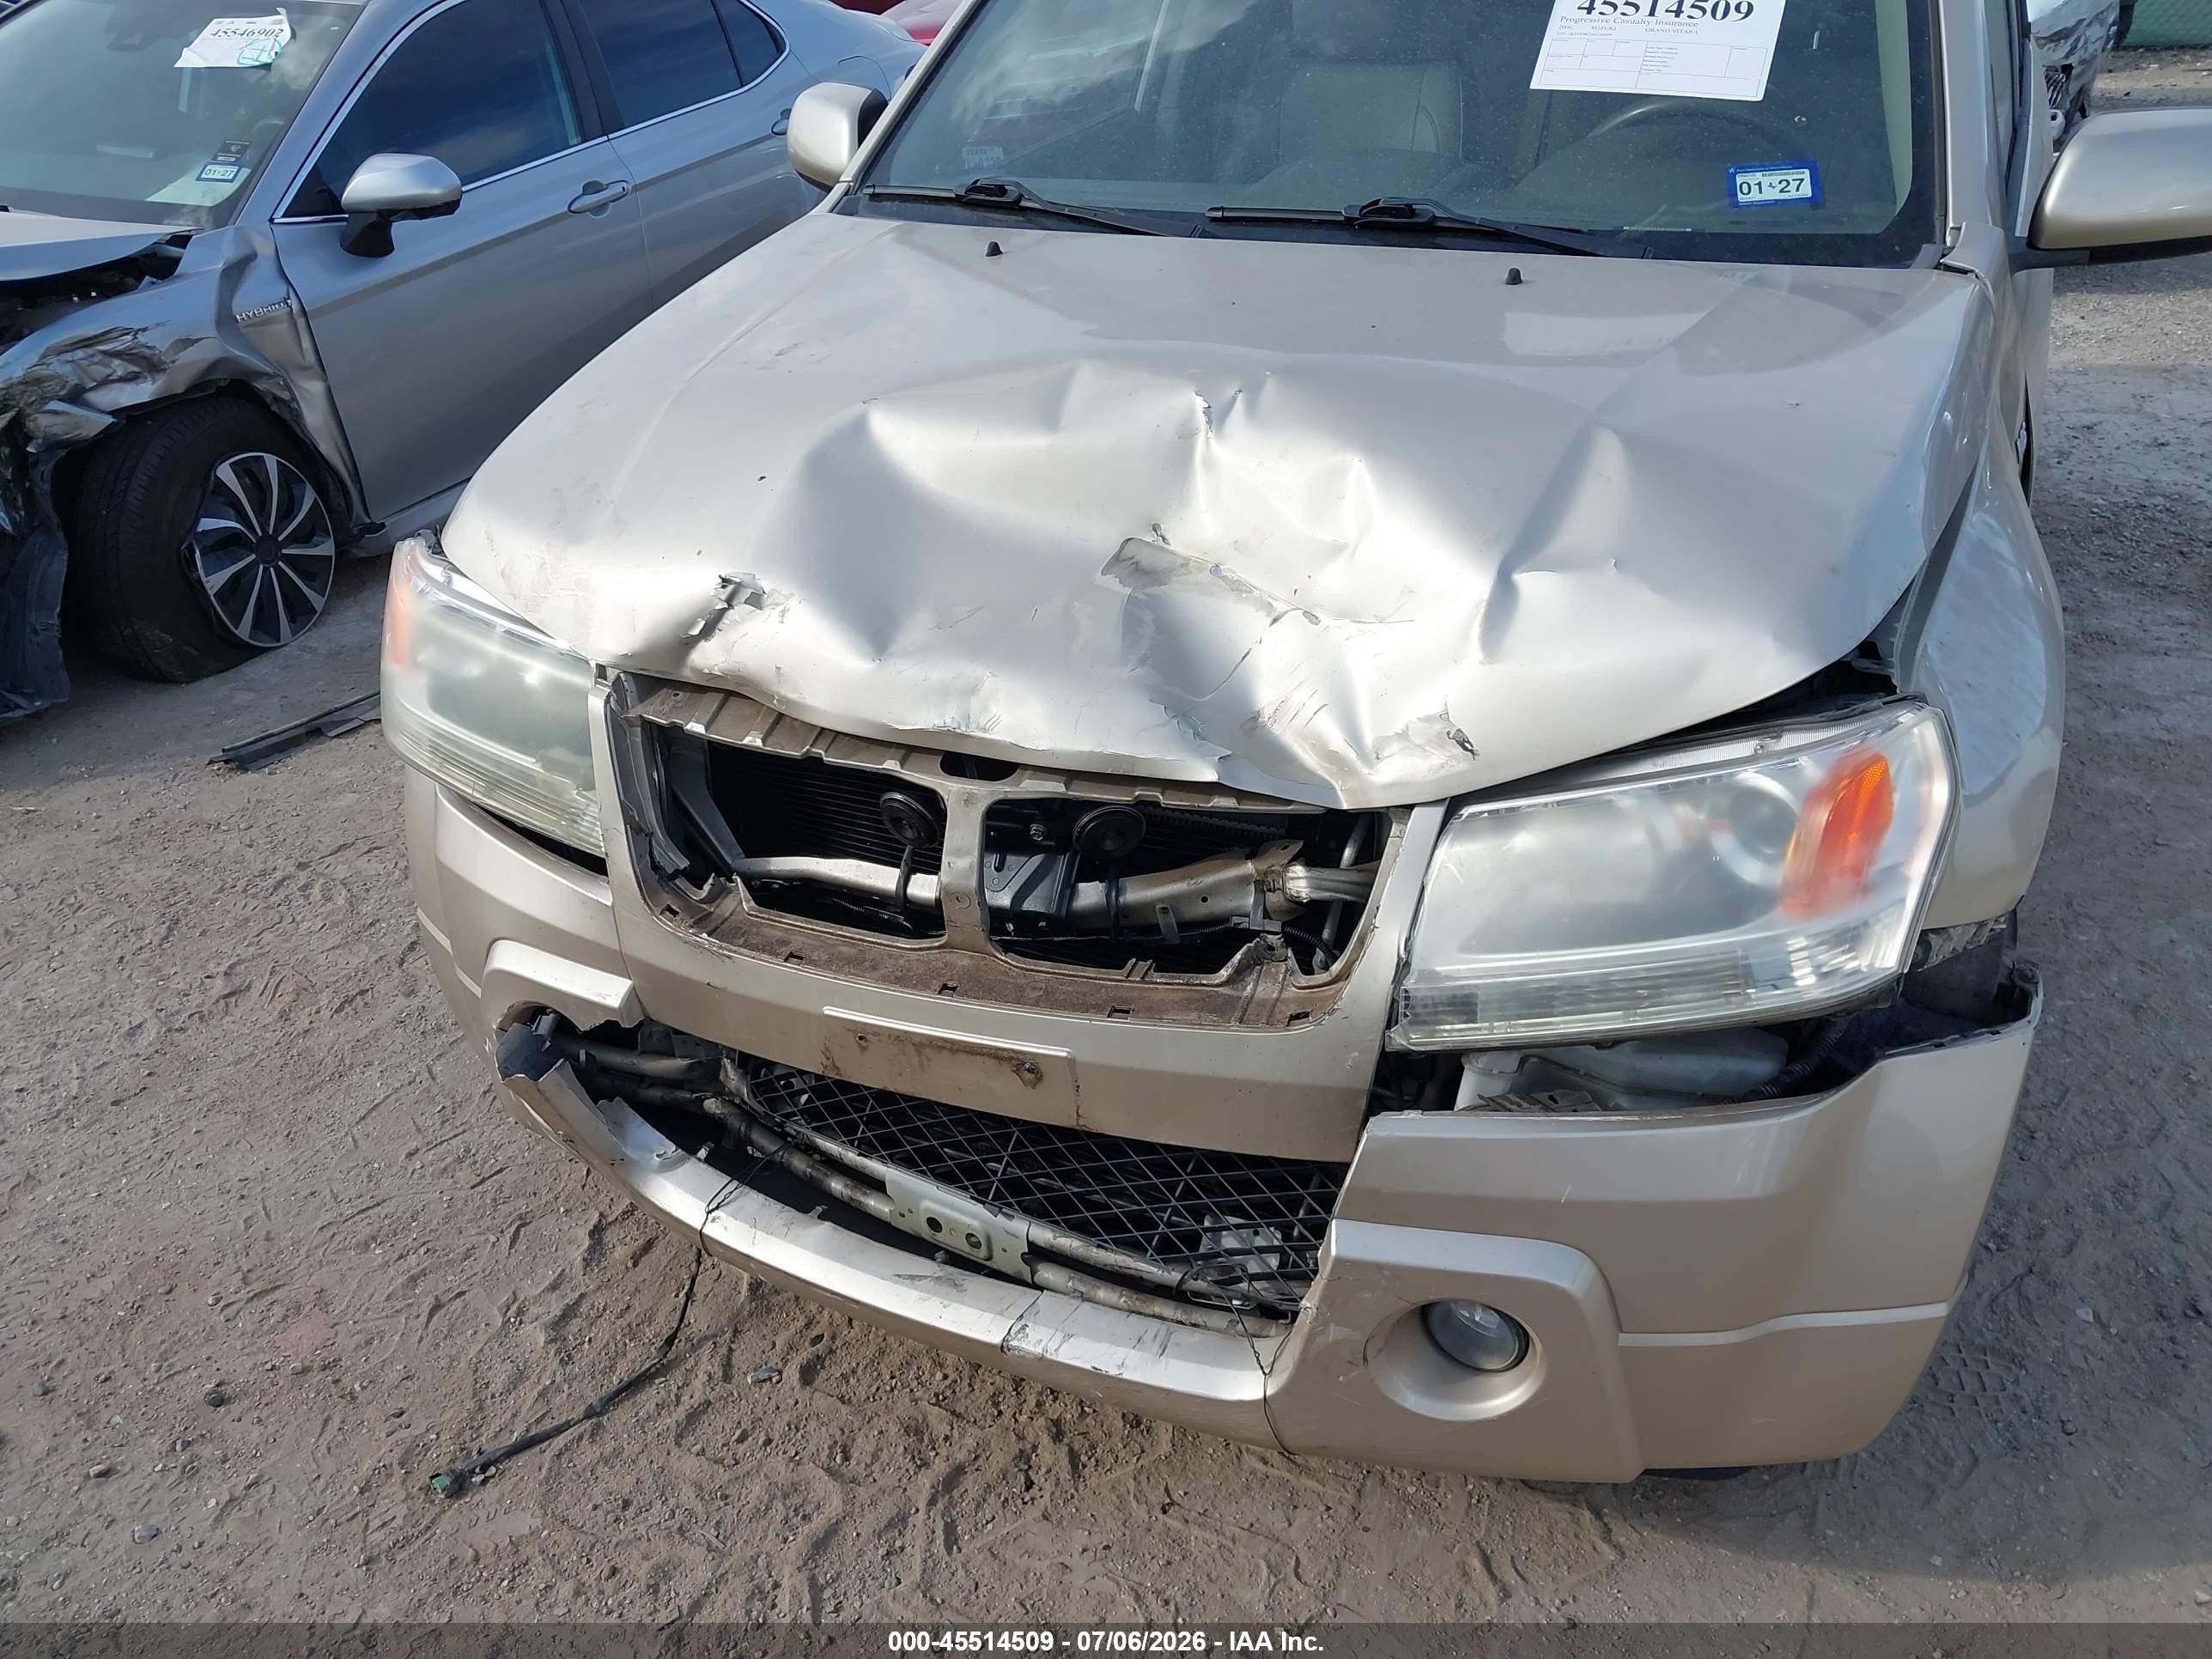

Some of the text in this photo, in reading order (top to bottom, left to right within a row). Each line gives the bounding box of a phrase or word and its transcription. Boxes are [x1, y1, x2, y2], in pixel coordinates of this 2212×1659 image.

[1559, 15, 1612, 25] Progressive
[1613, 17, 1652, 27] Casualty
[1739, 178, 1805, 196] 01 27
[235, 301, 289, 323] HYBRID
